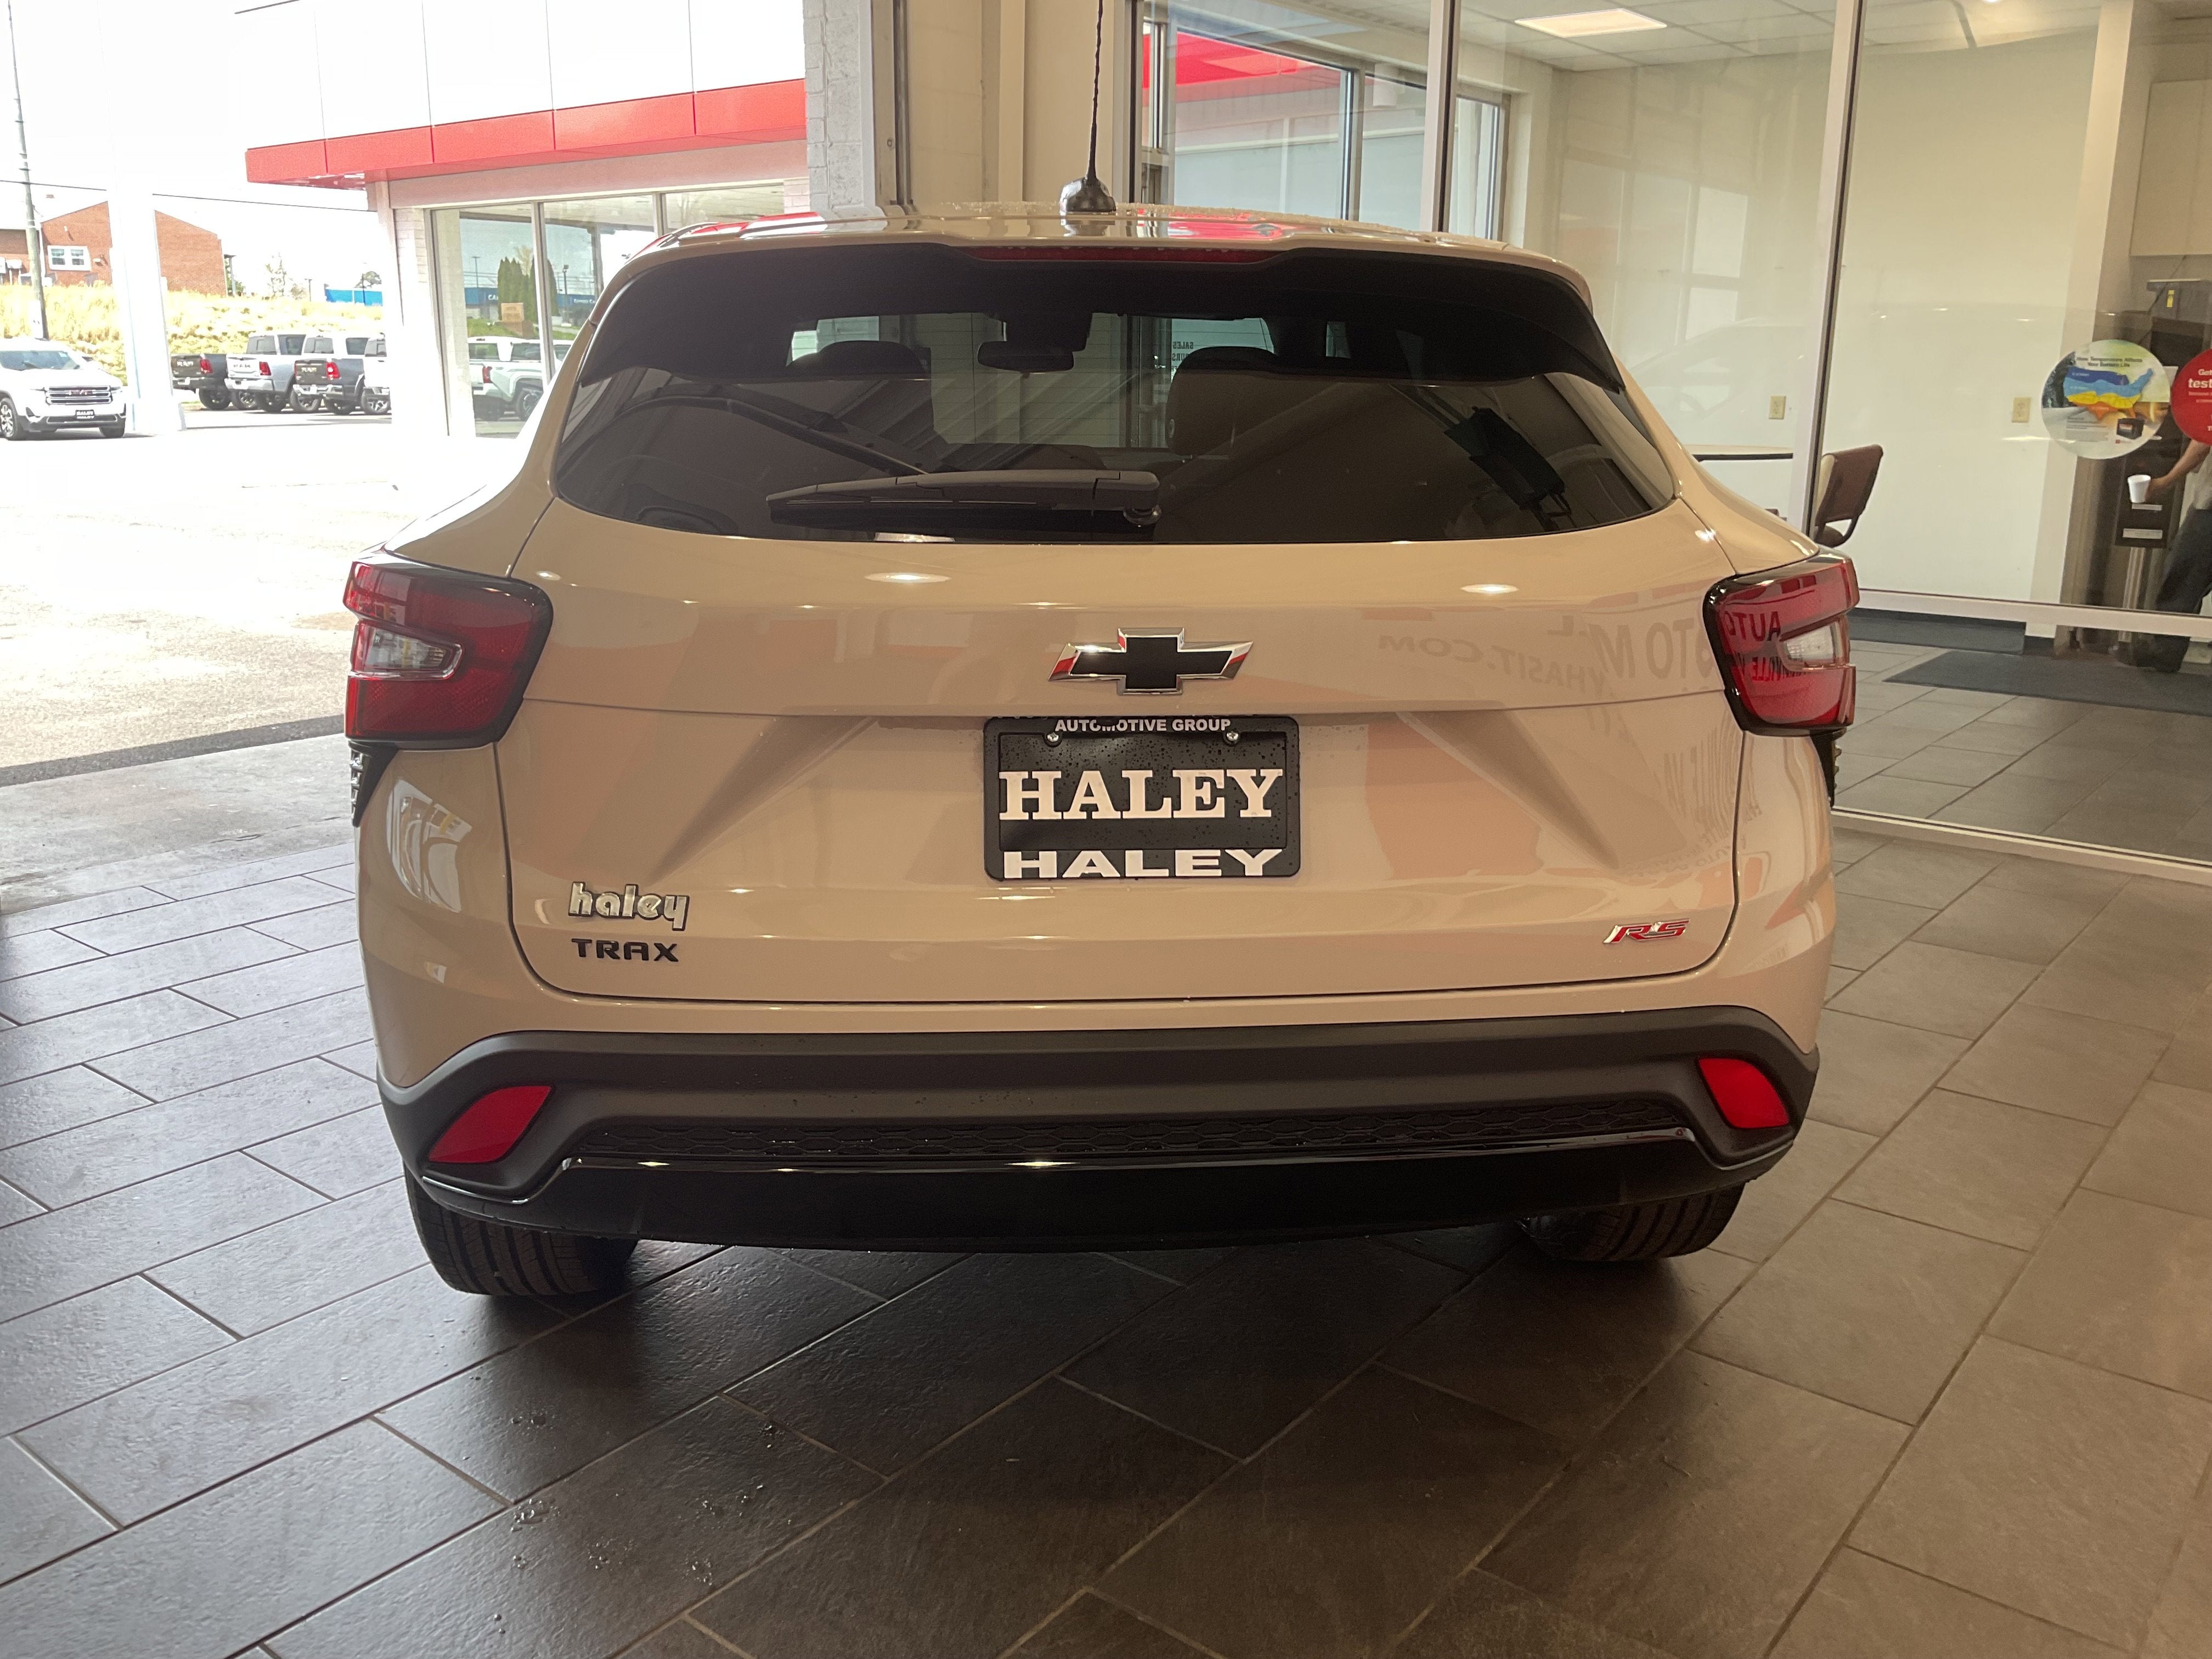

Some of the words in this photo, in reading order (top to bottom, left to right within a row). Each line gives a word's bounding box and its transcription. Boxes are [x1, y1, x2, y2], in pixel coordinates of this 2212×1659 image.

[1172, 719, 1231, 731] GROUP
[999, 769, 1283, 820] HALEY
[1003, 849, 1283, 878] HALEY
[568, 881, 690, 931] haley
[1602, 918, 1690, 943] RS
[571, 938, 679, 962] TRAX
